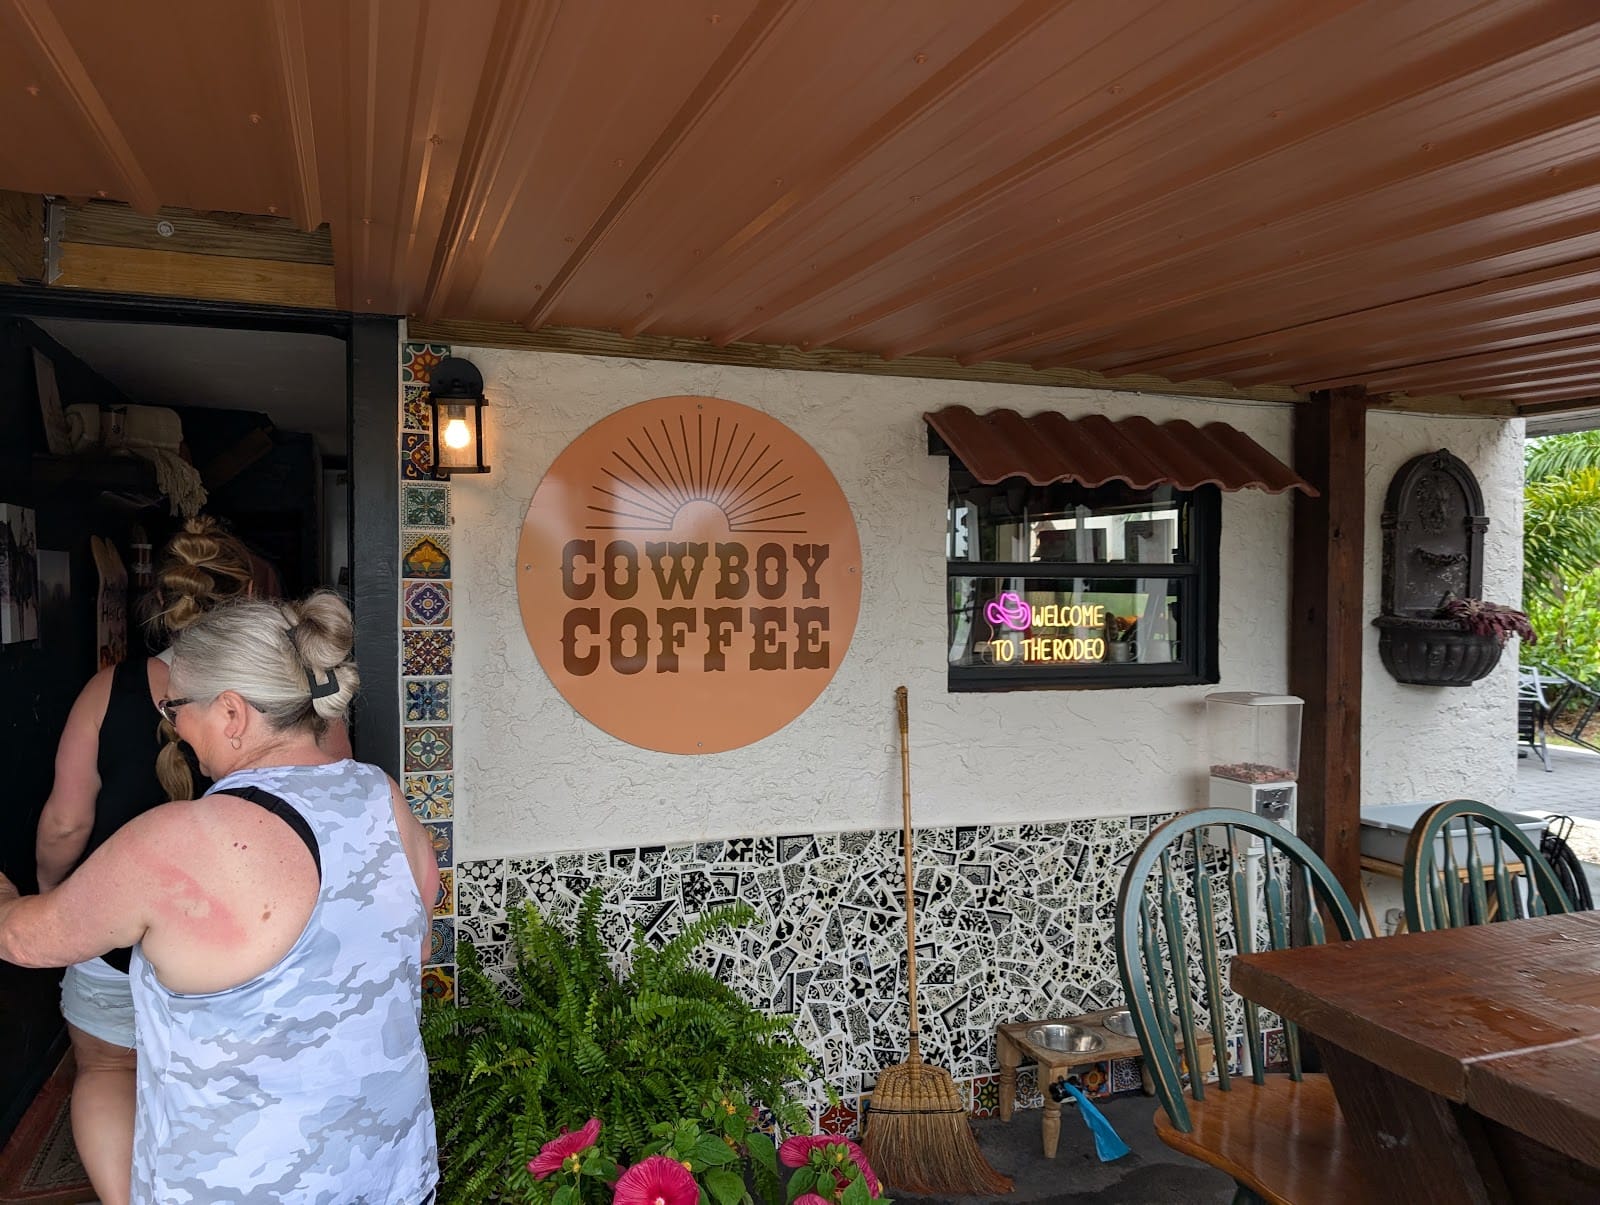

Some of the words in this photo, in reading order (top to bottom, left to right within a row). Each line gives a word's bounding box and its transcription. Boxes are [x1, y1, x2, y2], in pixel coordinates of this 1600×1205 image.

[560, 539, 830, 600] COWBOY
[1031, 605, 1105, 627] WELCOME
[560, 606, 830, 676] COFFEE
[991, 639, 1014, 662] TO
